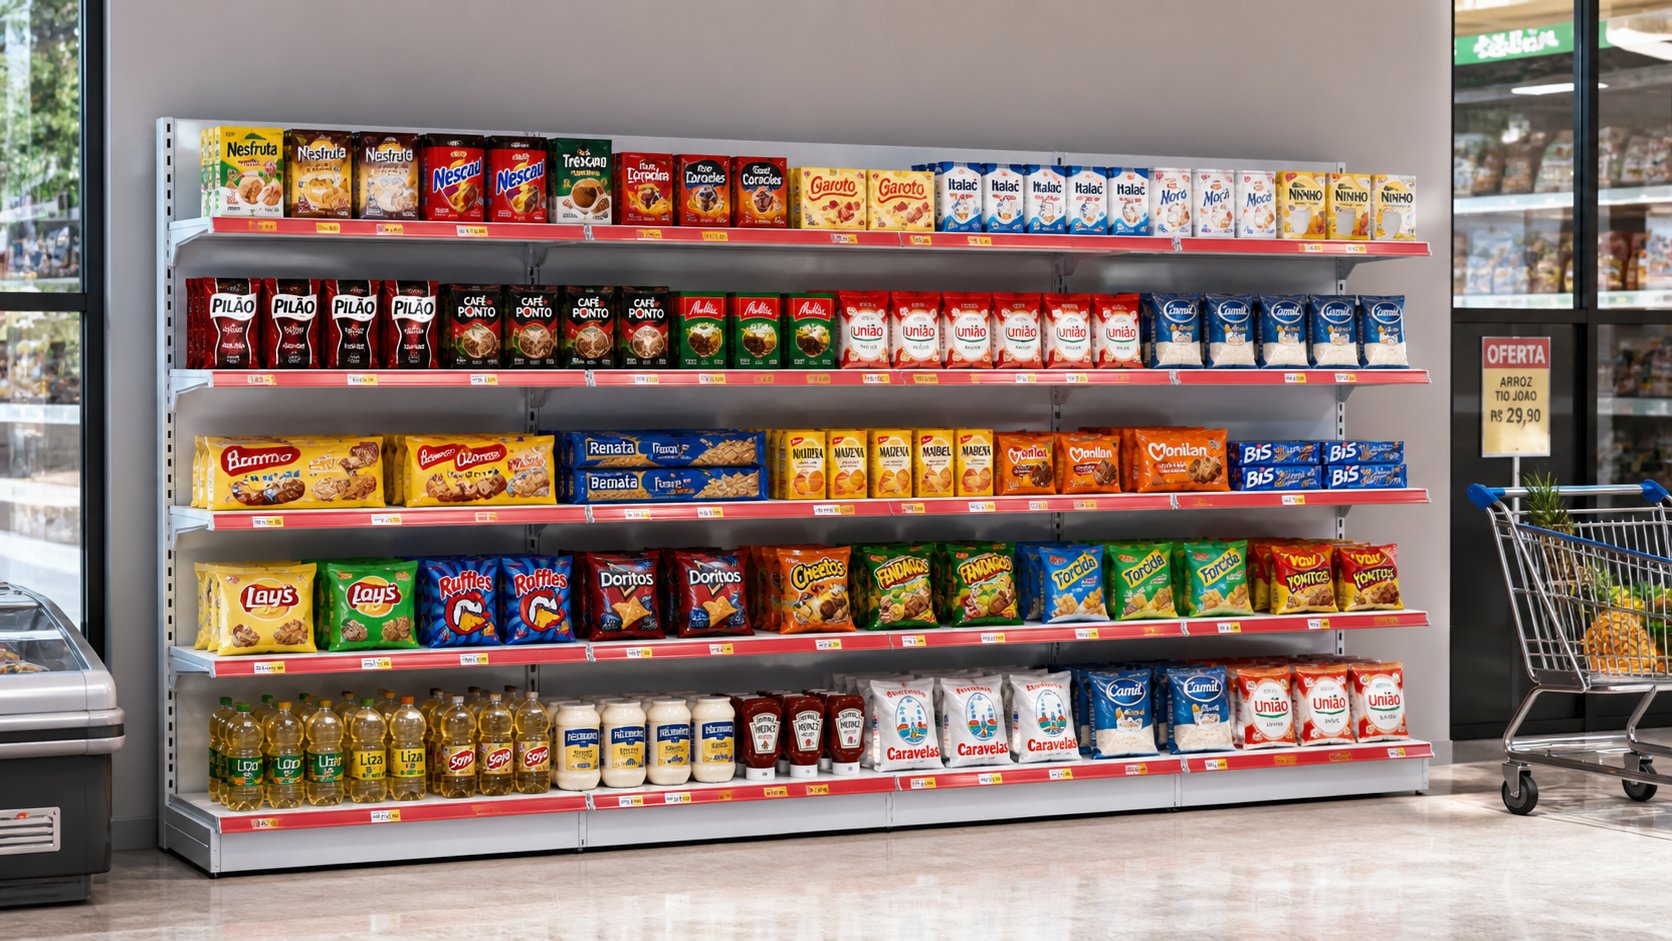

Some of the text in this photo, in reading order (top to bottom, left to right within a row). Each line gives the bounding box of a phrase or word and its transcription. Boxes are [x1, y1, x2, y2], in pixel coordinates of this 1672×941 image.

[227, 141, 277, 159] Nesfruta
[432, 157, 482, 193] Nescau
[496, 159, 545, 194] Nescau
[1335, 190, 1368, 202] NINHO
[464, 295, 486, 306] CAFÉ
[521, 296, 543, 307] CAFÉ
[578, 297, 600, 308] CAFÉ
[458, 306, 496, 318] PONTO
[516, 307, 552, 319] PONTO
[572, 307, 609, 319] PONTO
[629, 307, 664, 319] PONTO
[1487, 344, 1546, 364] OFERTA
[1499, 376, 1533, 388] ARROZ
[1495, 390, 1537, 402] TIO JOAO
[1506, 407, 1541, 429] 29,90
[590, 442, 635, 455] Renata
[438, 570, 492, 600] Ruffles
[601, 572, 654, 587] Doritos
[1108, 683, 1144, 697] Camil
[1185, 680, 1219, 695] Camil
[957, 741, 1009, 757] Caravelas
[1027, 737, 1079, 752] Caravelas
[360, 752, 383, 766] Liza
[401, 750, 423, 763] Liza
[887, 746, 940, 762] Caravelas
